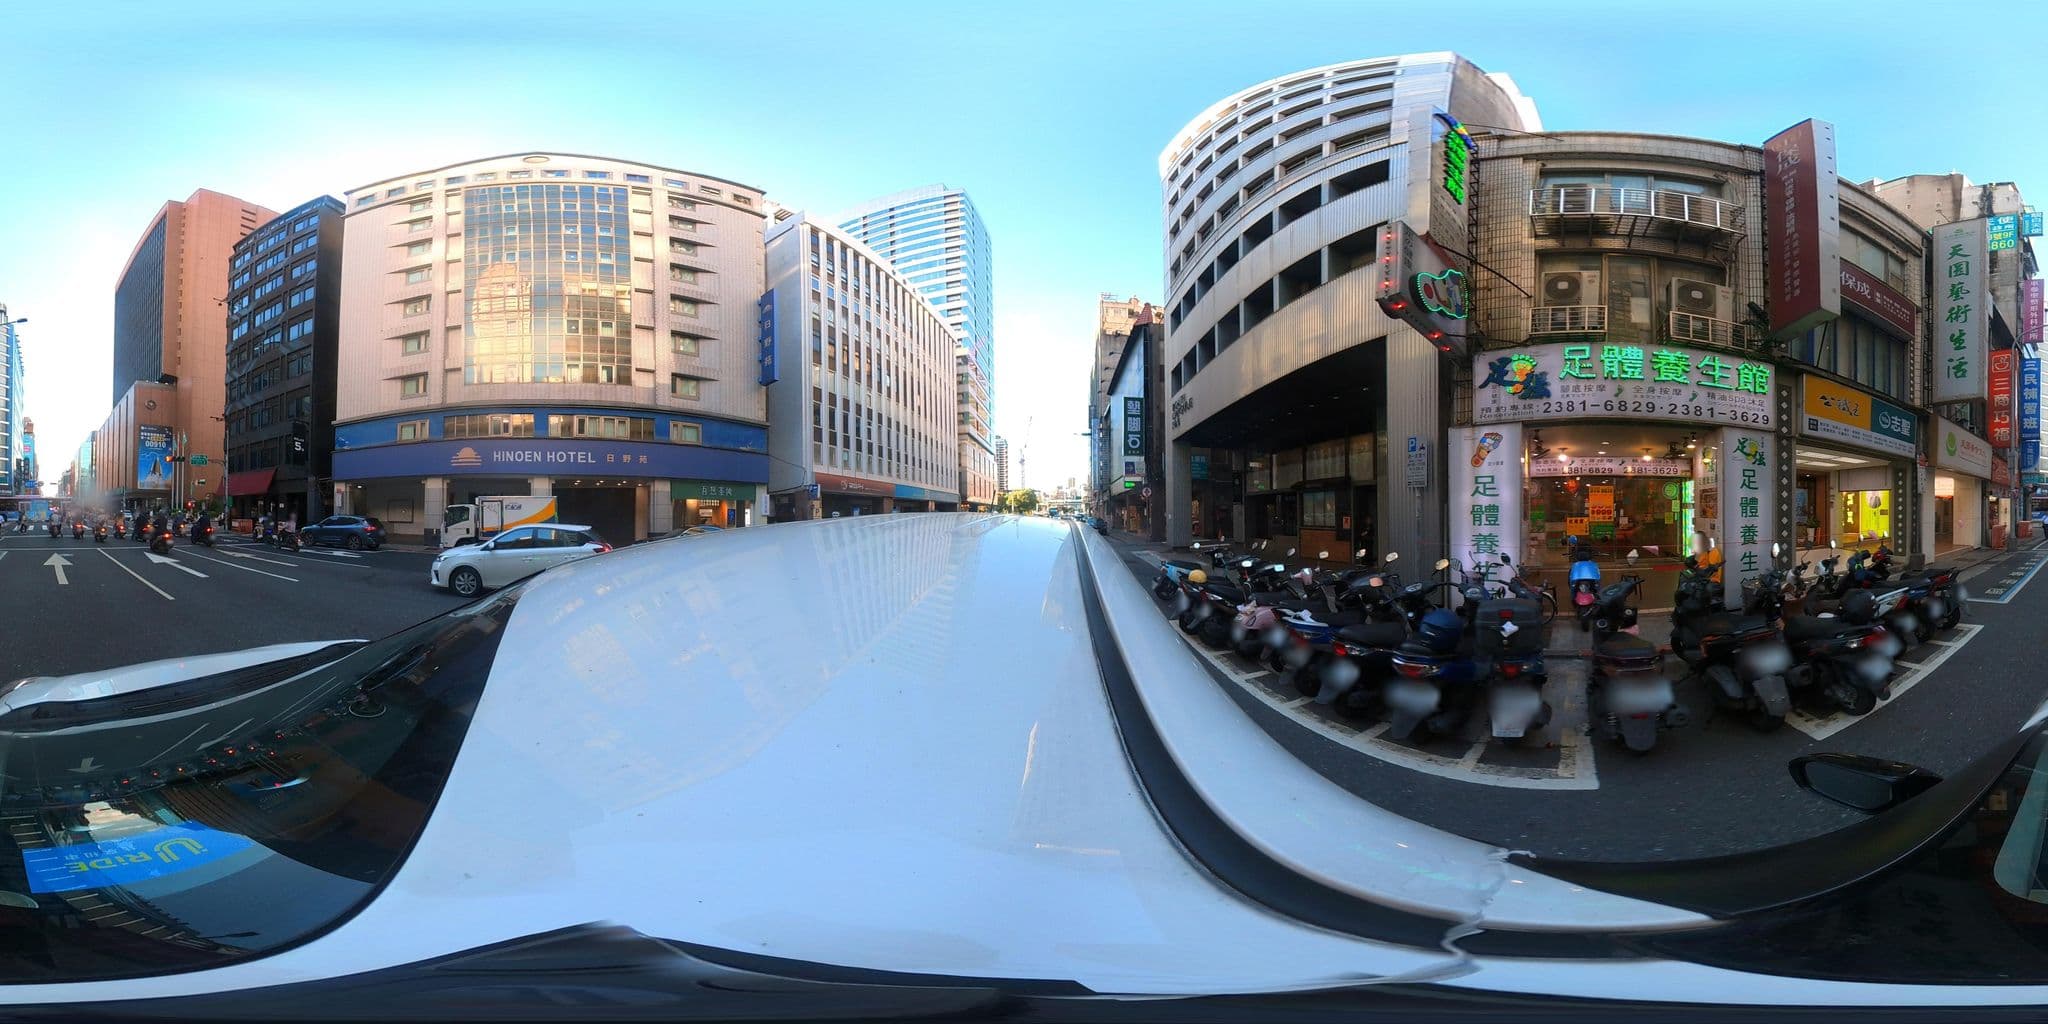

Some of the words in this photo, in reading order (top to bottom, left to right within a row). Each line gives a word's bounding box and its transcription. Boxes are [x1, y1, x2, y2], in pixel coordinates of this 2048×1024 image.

[1839, 271, 1871, 300] 保成
[1559, 345, 1771, 395] 足體養生館
[1632, 385, 1682, 396] 全身按摩
[2023, 361, 2039, 429] 三民補習班
[1543, 400, 1656, 414] 2381-6829
[1667, 402, 1770, 425] 2381-3629
[1993, 377, 2010, 441] 三商巧福
[1891, 415, 1911, 437] 志聖
[493, 451, 542, 463] HINOEN
[547, 451, 597, 464] HOTEL
[606, 454, 648, 464] 日野苑
[1470, 475, 1500, 598] 足體養生
